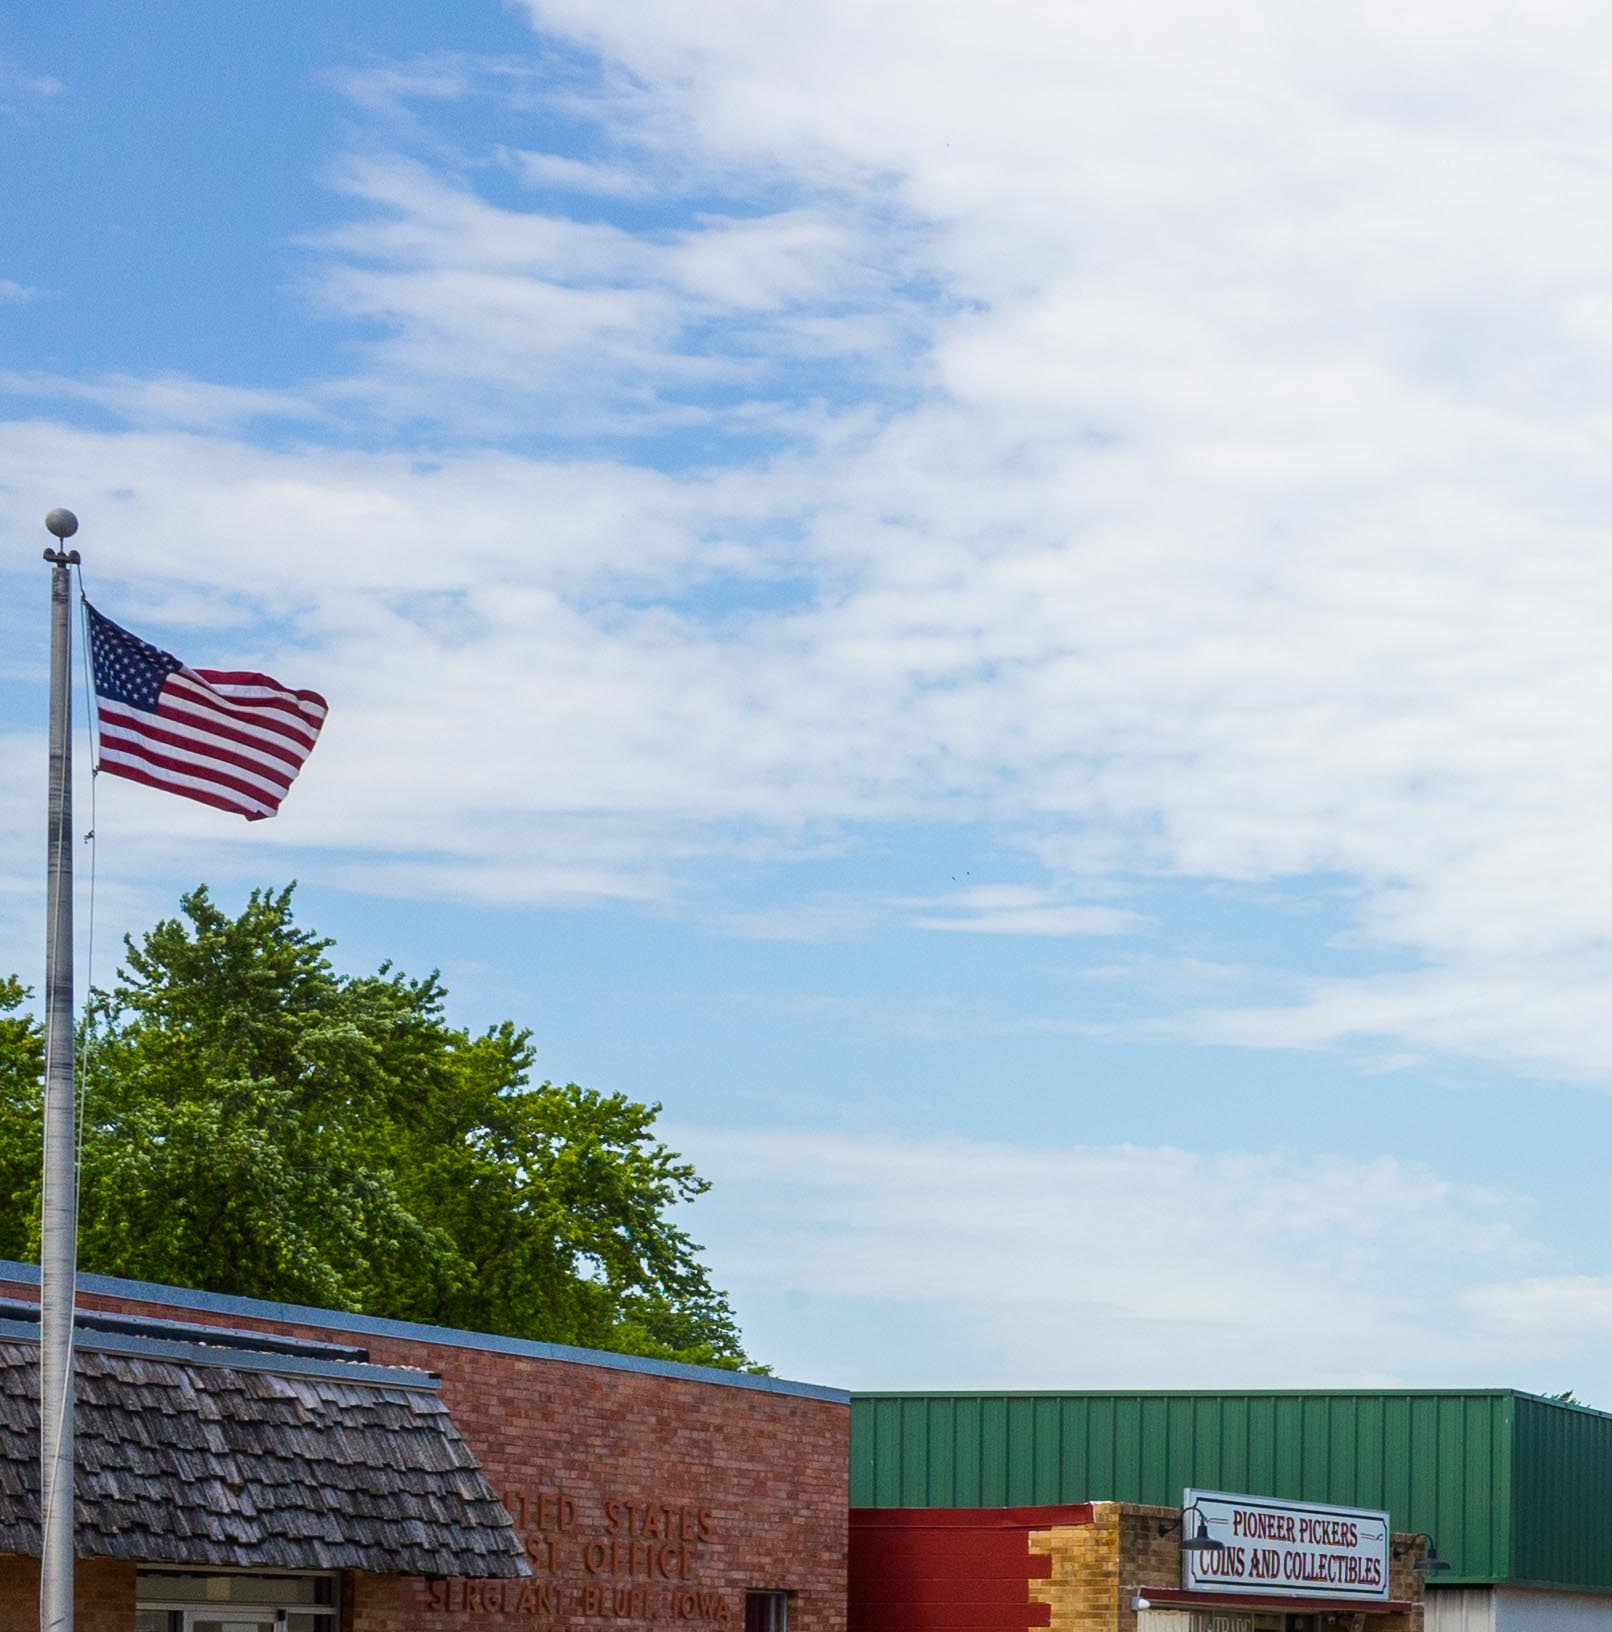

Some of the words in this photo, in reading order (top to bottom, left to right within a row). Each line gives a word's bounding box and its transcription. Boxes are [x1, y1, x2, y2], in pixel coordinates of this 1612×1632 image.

[503, 1491, 577, 1531] ITED
[606, 1500, 714, 1542] STATES
[1233, 1510, 1296, 1543] PIONEER
[1300, 1517, 1358, 1548] PICKERS
[526, 1535, 558, 1573] ST
[585, 1540, 697, 1580] OFFICE
[1200, 1547, 1245, 1577] COINS
[1249, 1549, 1280, 1580] AND
[1284, 1552, 1381, 1586] COLLECTIBLES
[430, 1578, 565, 1614] SERGEANT
[673, 1590, 731, 1621] IOWA
